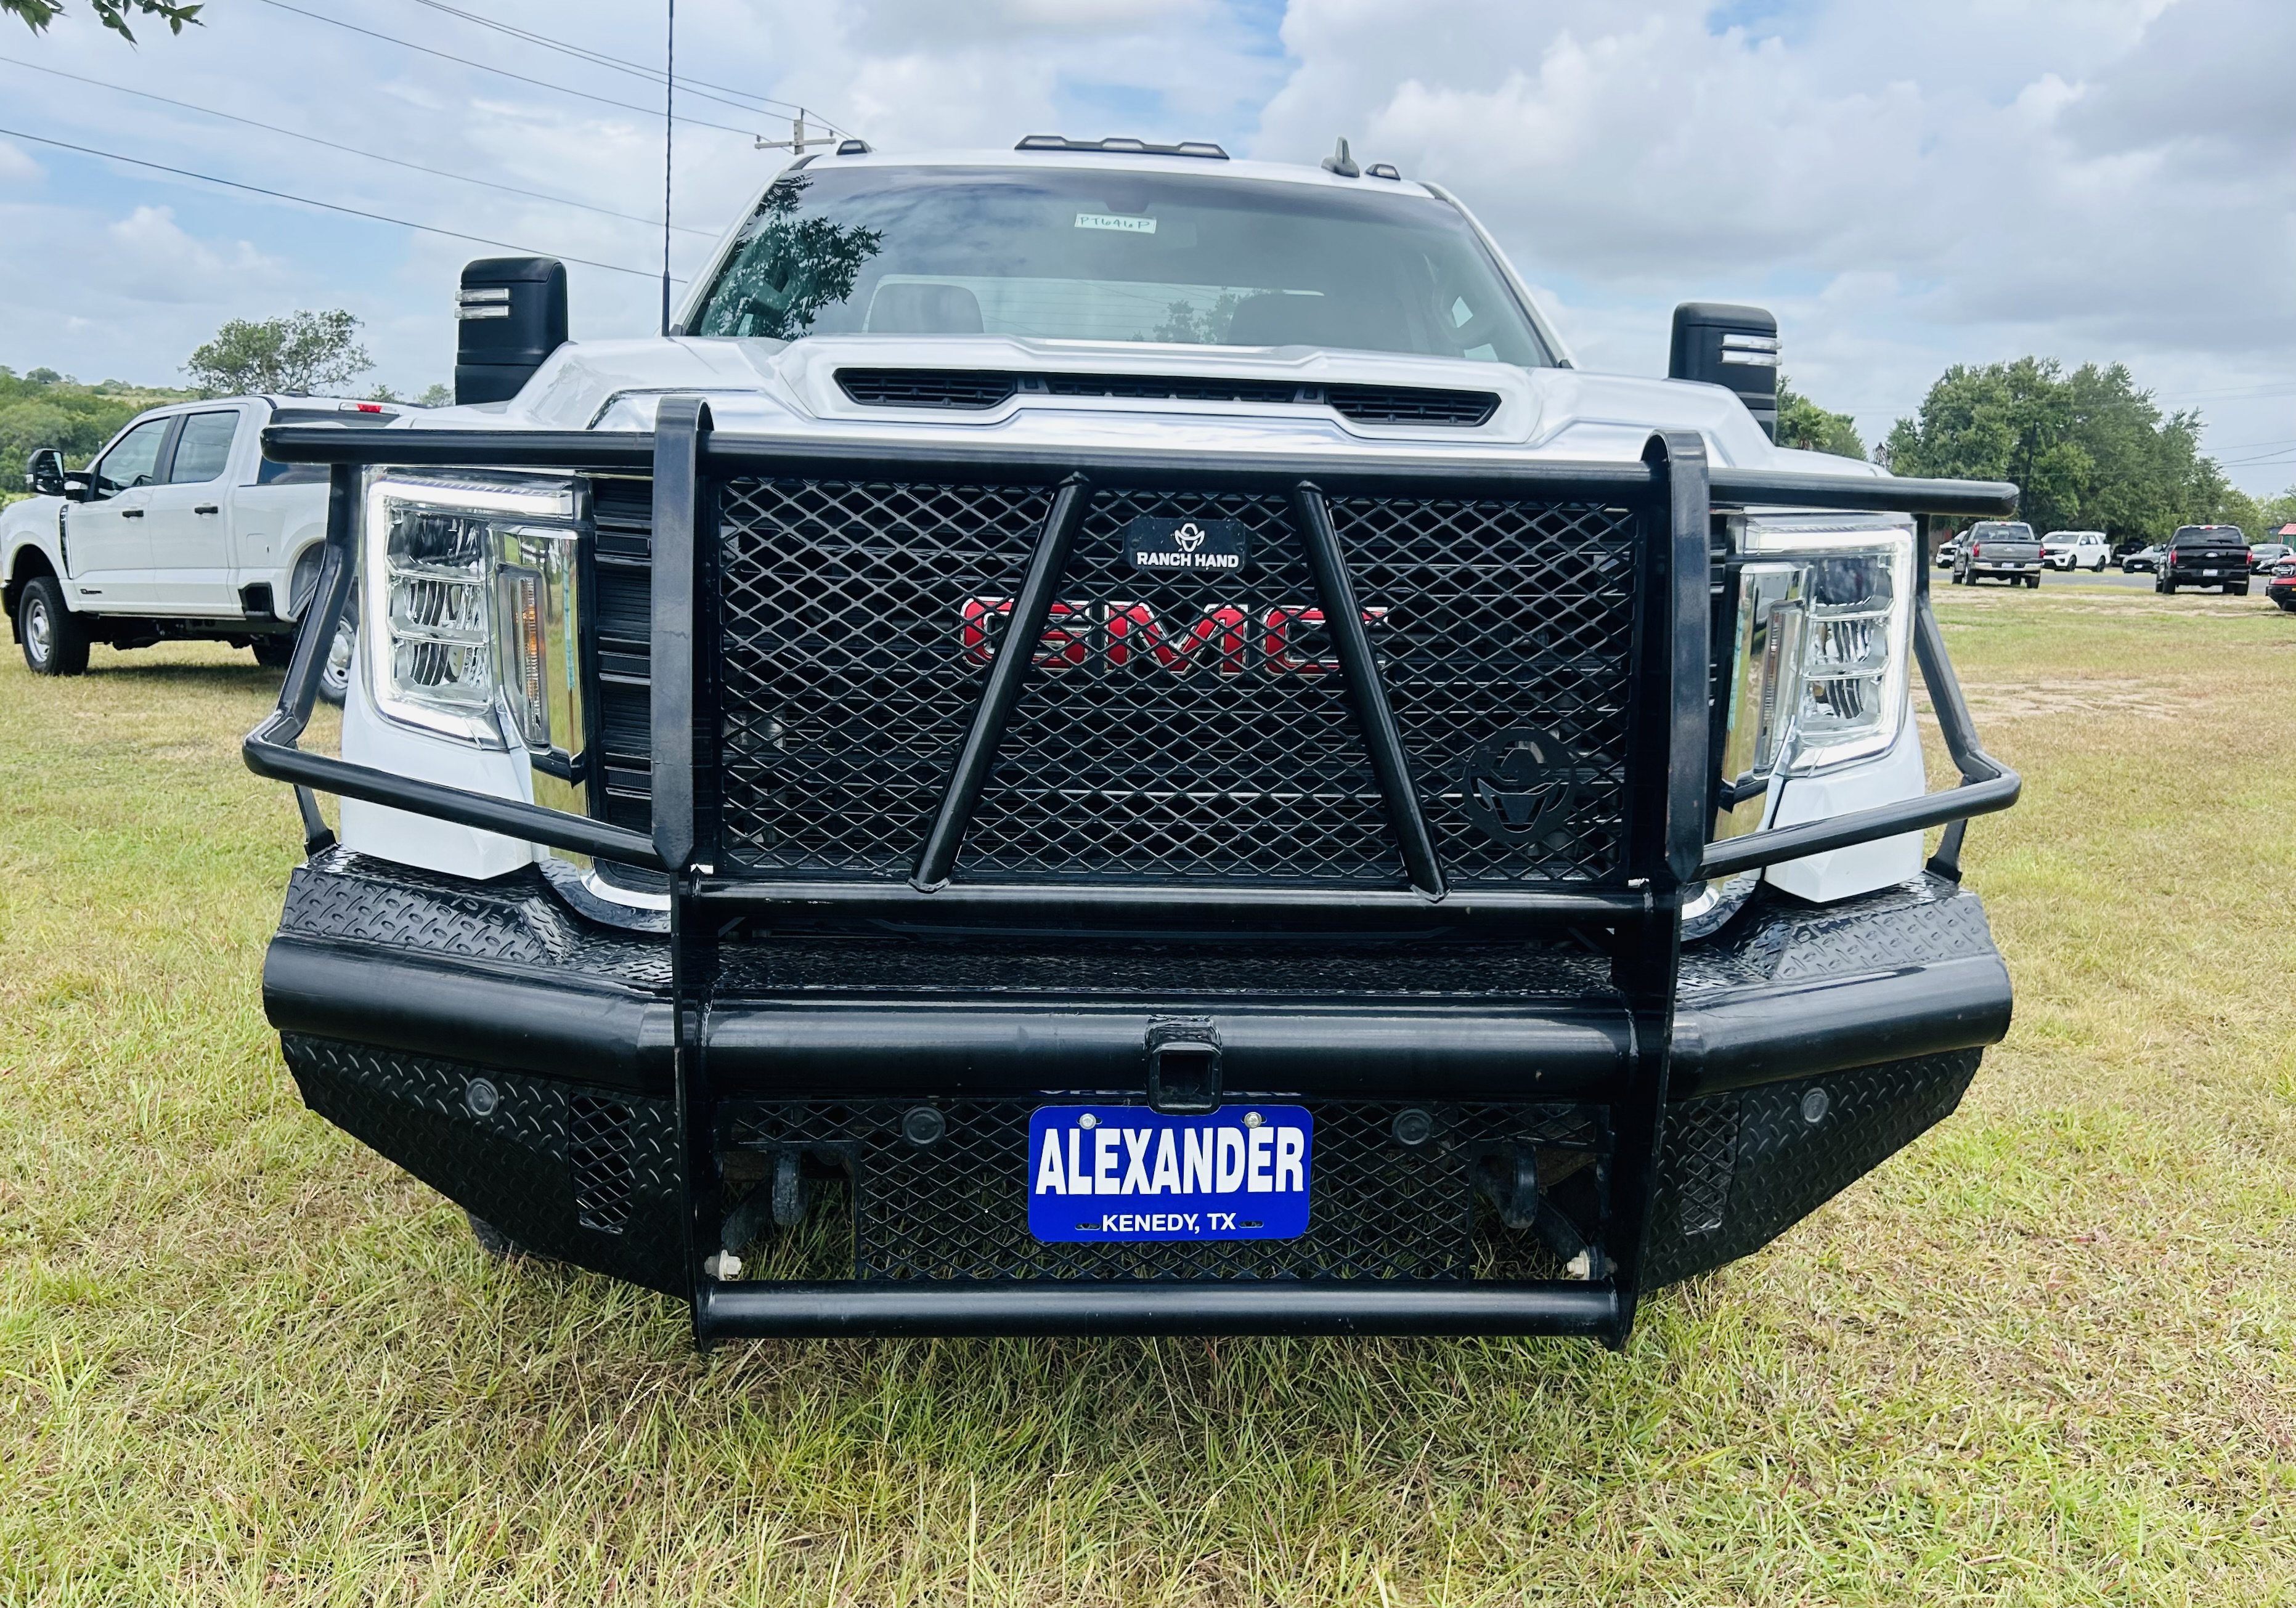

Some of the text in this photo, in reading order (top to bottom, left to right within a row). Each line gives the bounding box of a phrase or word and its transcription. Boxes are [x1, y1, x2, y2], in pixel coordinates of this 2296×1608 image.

[1136, 551, 1239, 567] RANCH HAND
[959, 596, 1388, 676] GMC
[1035, 1127, 1305, 1195] ALEXANDER
[1102, 1212, 1237, 1235] KENEDY, TX
